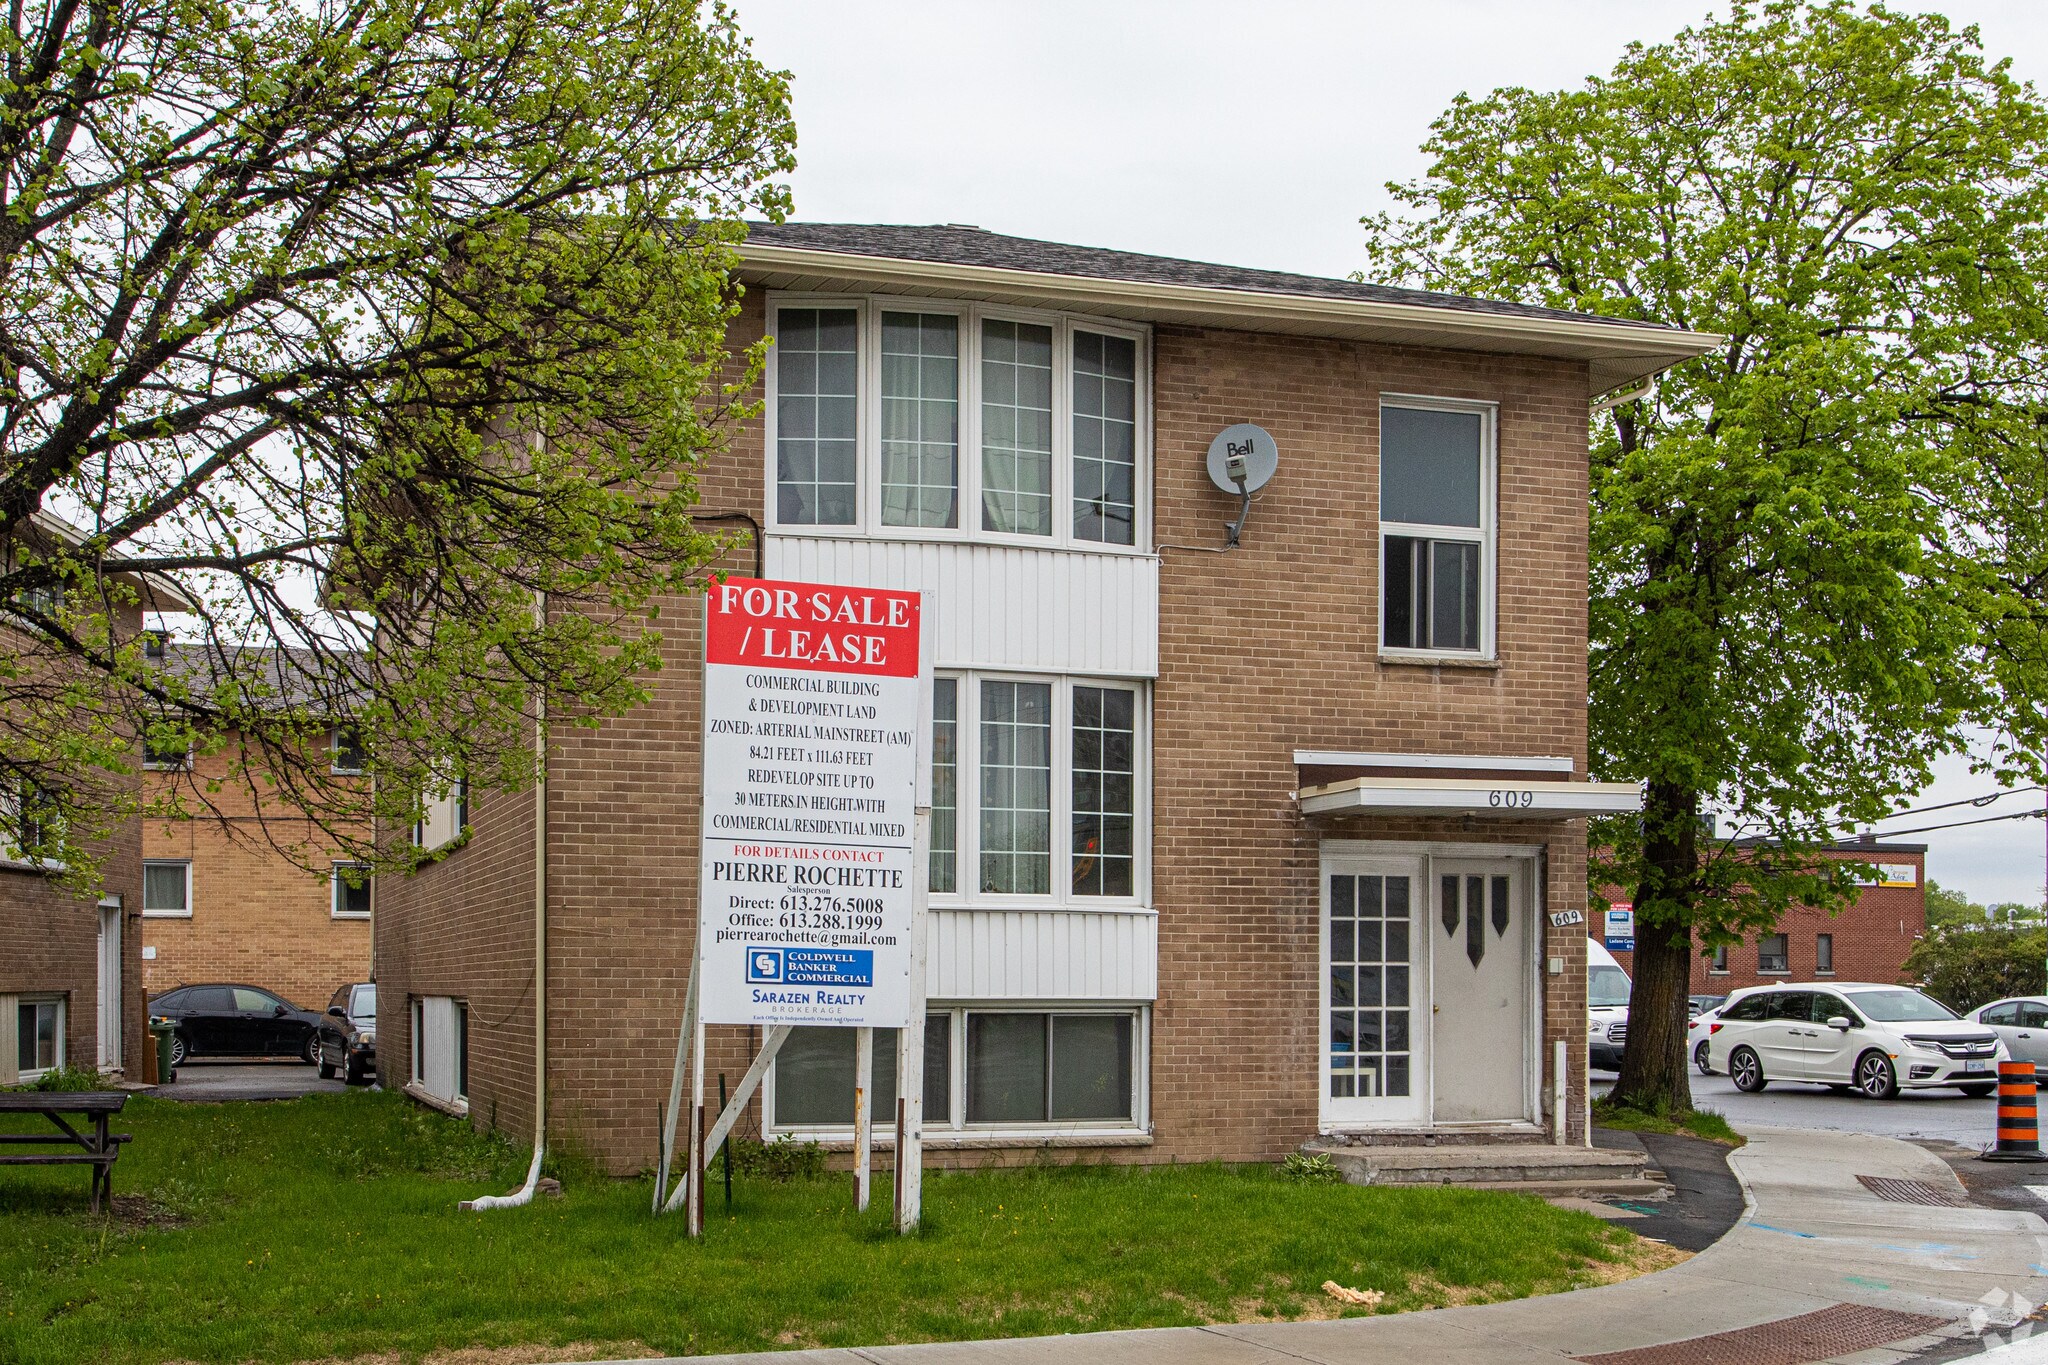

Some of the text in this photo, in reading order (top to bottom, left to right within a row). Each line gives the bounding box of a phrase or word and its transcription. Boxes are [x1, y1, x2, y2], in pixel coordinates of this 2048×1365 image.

[1226, 439, 1254, 457] Bell
[718, 585, 910, 628] FOR SALE
[739, 627, 887, 665] / LEASE
[746, 674, 880, 697] COMMERCIAL BUILDING
[749, 698, 876, 719] & DEVELOPMENT LAND
[711, 719, 911, 748] ZONED: ARTERIAL MAINSTREET (AM)
[750, 746, 873, 766] 84.21 FEET x 111.63 FEET
[748, 769, 874, 789] REDEVELOP SITE UP TO
[735, 792, 885, 813] 30 METERS IN HEIGHT WITH
[1489, 790, 1533, 808] 609
[713, 814, 905, 837] COMMERCIAL/RESIDENTIAL MIXED
[734, 845, 884, 862] FOR DETAILS CONTACT
[713, 862, 903, 888] PIERRE ROCHETTE
[787, 886, 830, 895] Salesperson
[729, 895, 883, 913] Direct: 613.276.5008
[729, 913, 883, 930] Office: 613.288.1999
[1555, 910, 1578, 926] 609
[716, 928, 897, 946] pierrearochette@gmail.com
[788, 952, 856, 962] COLDWELL
[788, 962, 836, 972] BANKER
[788, 972, 869, 983] COMMERCIAL
[752, 989, 865, 1005] SARAZEN REALTY
[772, 1006, 842, 1014] BROKERAGE
